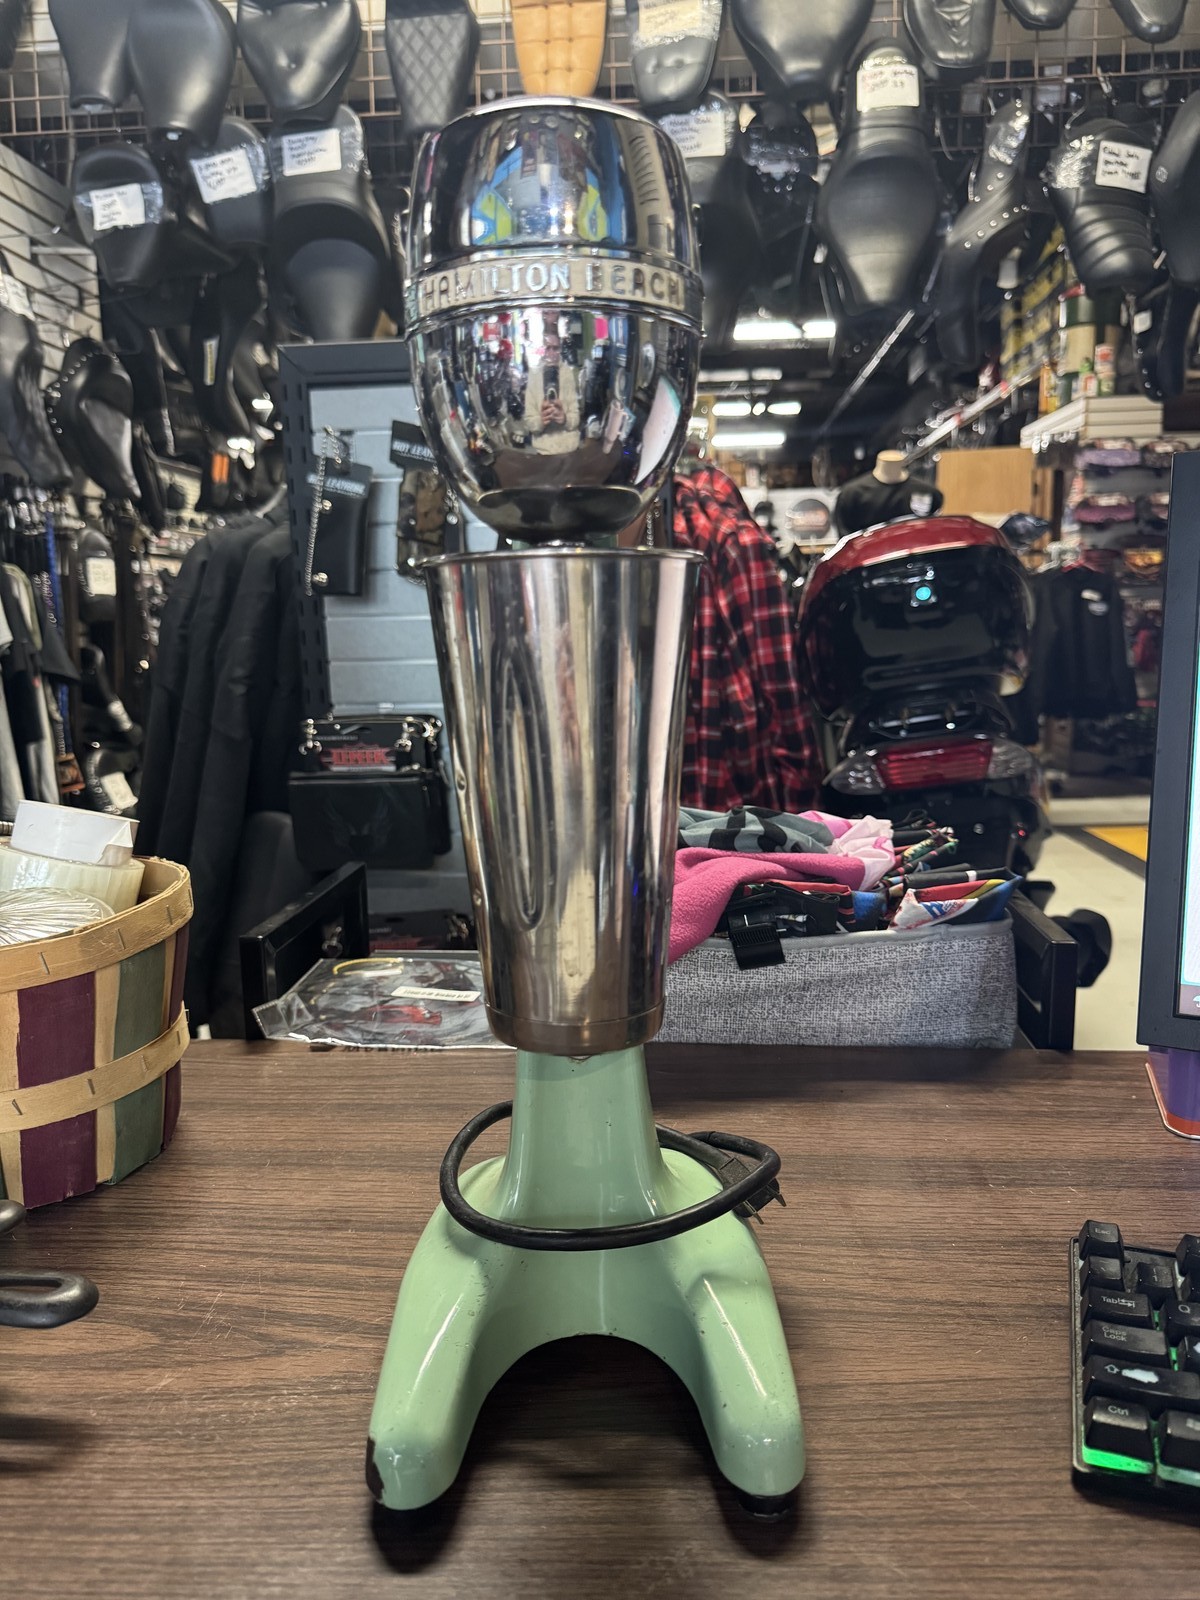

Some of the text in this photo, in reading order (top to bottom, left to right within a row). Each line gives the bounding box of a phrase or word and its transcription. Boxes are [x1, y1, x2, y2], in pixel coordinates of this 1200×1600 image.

[421, 262, 683, 312] HAMILTON BEACH
[1101, 1296, 1119, 1304] Tab
[1178, 1304, 1191, 1314] Q
[1102, 1325, 1127, 1336] Caps
[1103, 1330, 1127, 1342] Lock
[1107, 1405, 1130, 1416] Ctrl
